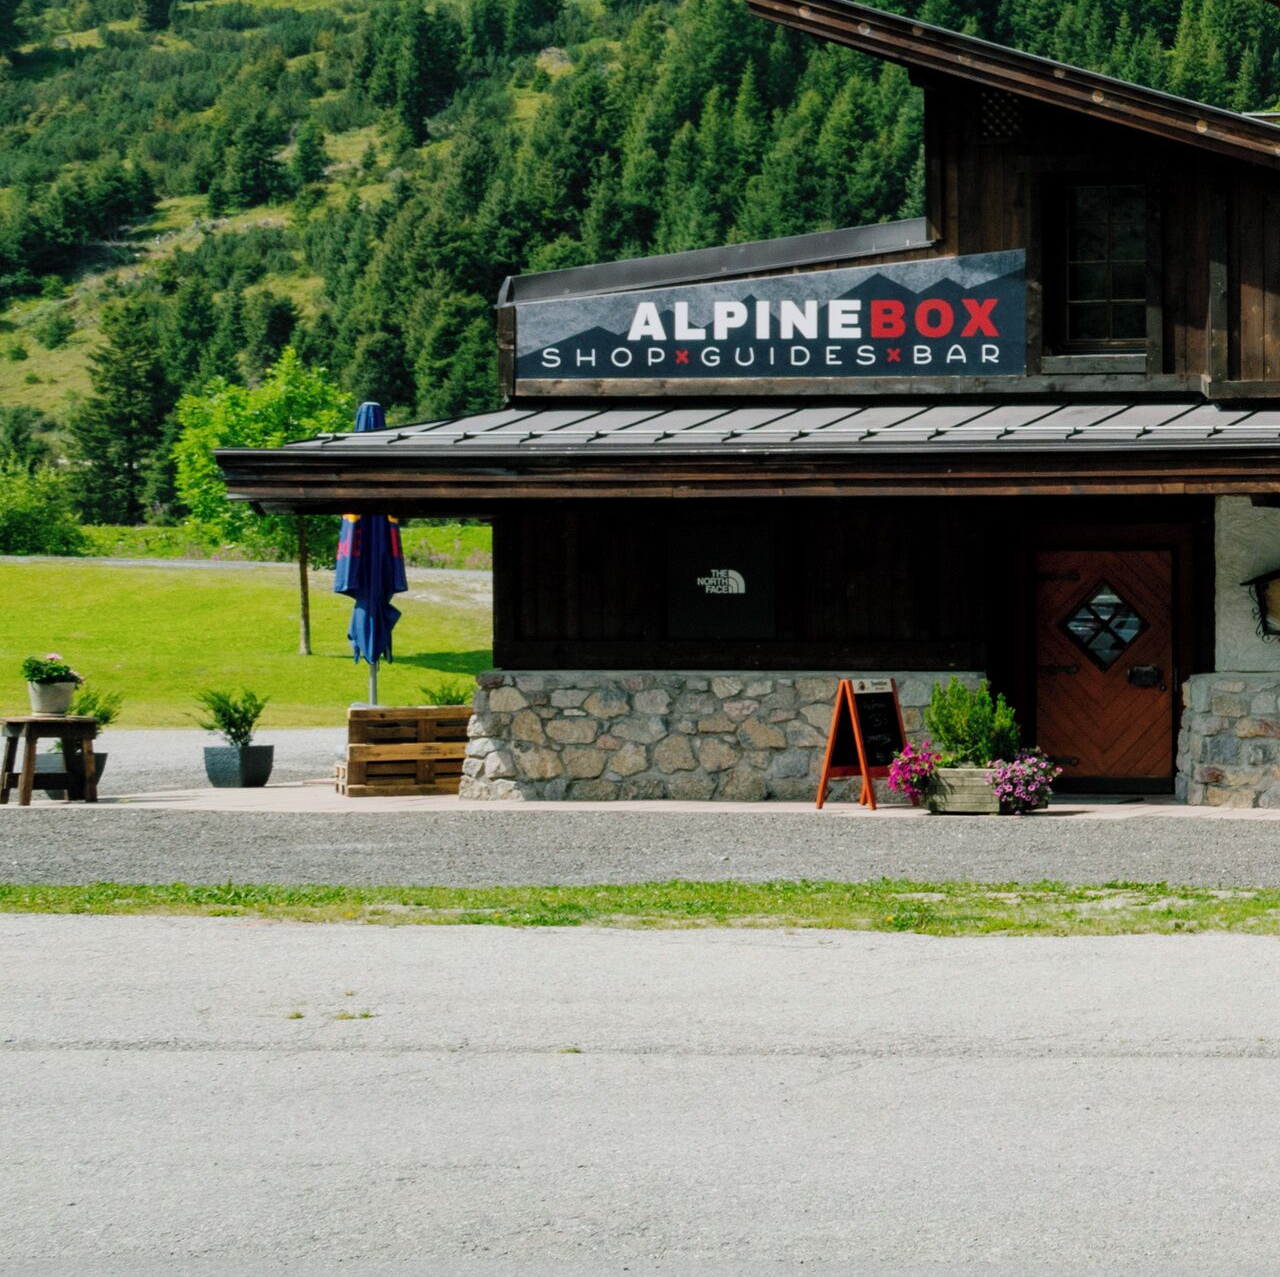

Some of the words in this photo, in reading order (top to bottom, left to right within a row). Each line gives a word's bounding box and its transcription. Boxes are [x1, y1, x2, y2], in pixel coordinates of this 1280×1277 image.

[541, 347, 666, 368] SHOP
[700, 345, 877, 368] GUIDES
[912, 344, 1000, 365] BAR
[710, 569, 728, 578] THE
[697, 577, 728, 586] NORTH
[705, 585, 728, 594] FACE
